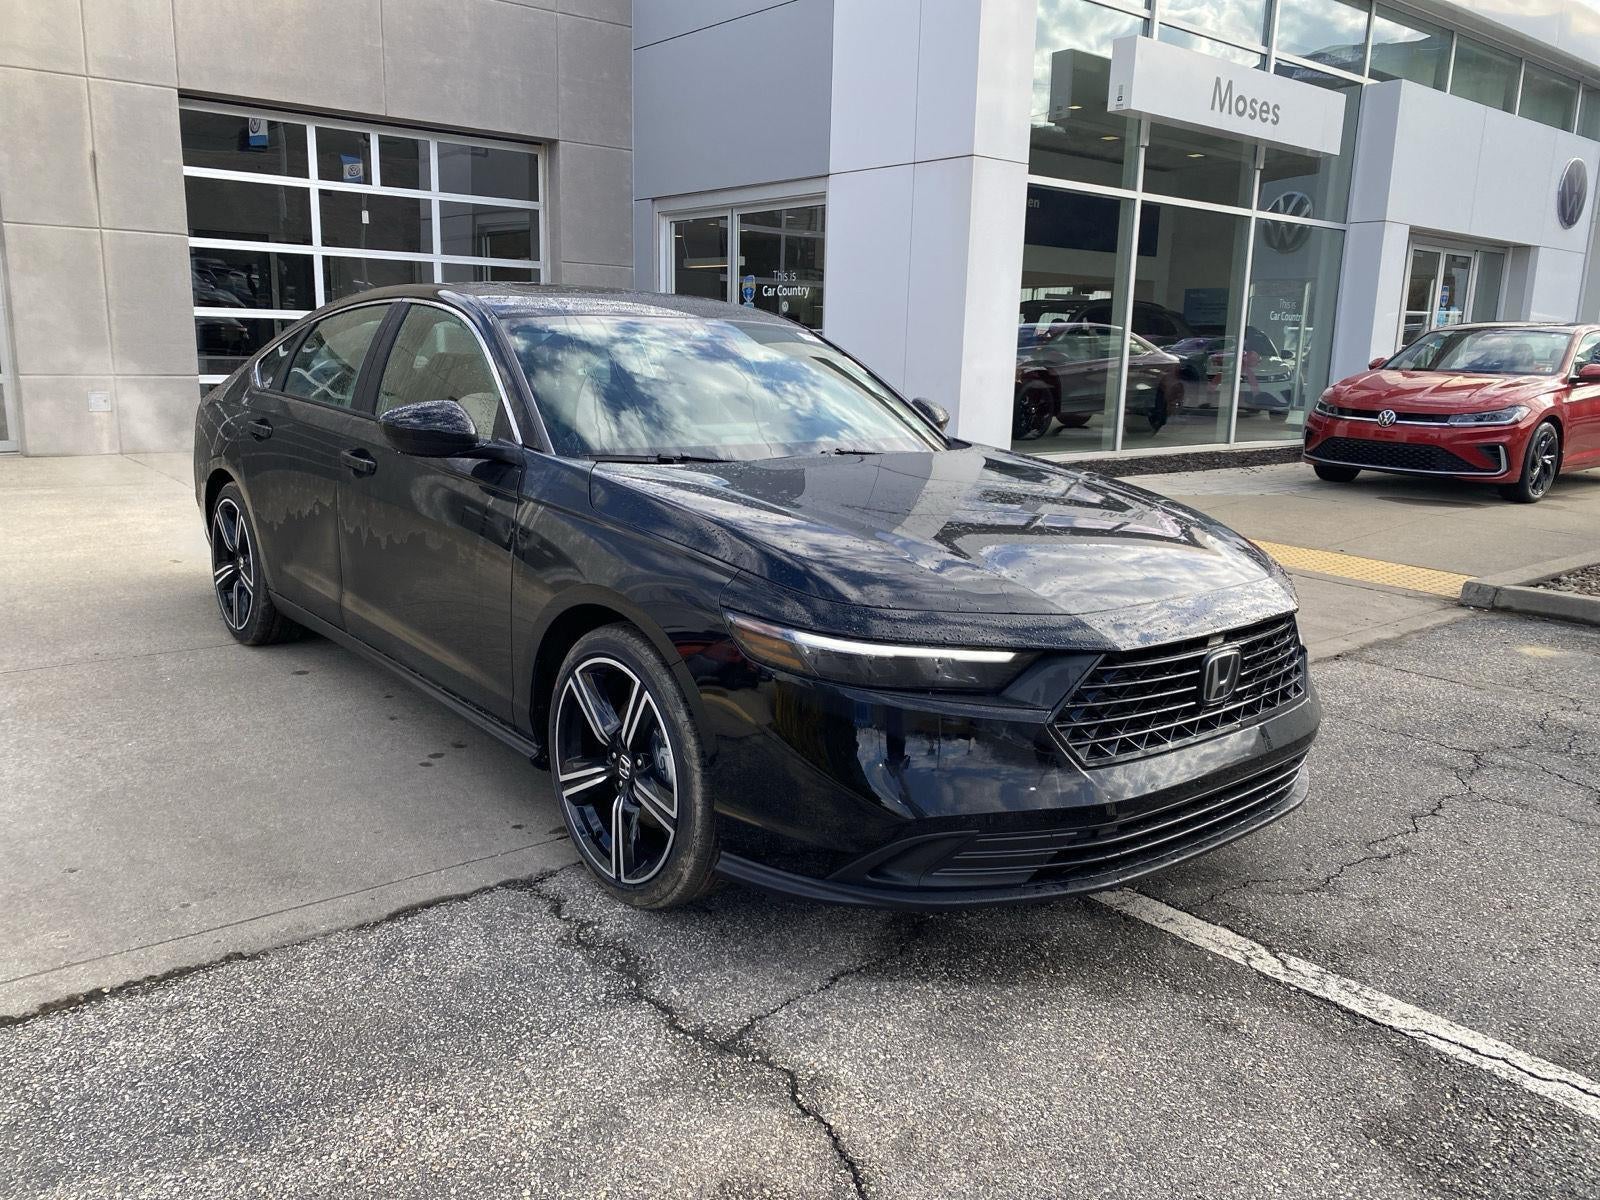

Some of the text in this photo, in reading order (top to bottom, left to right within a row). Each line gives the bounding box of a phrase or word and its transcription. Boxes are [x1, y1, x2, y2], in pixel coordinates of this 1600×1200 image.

[1210, 76, 1281, 126] Moses
[773, 270, 796, 281] This is
[762, 285, 810, 298] Car Country
[1270, 311, 1280, 320] Car
